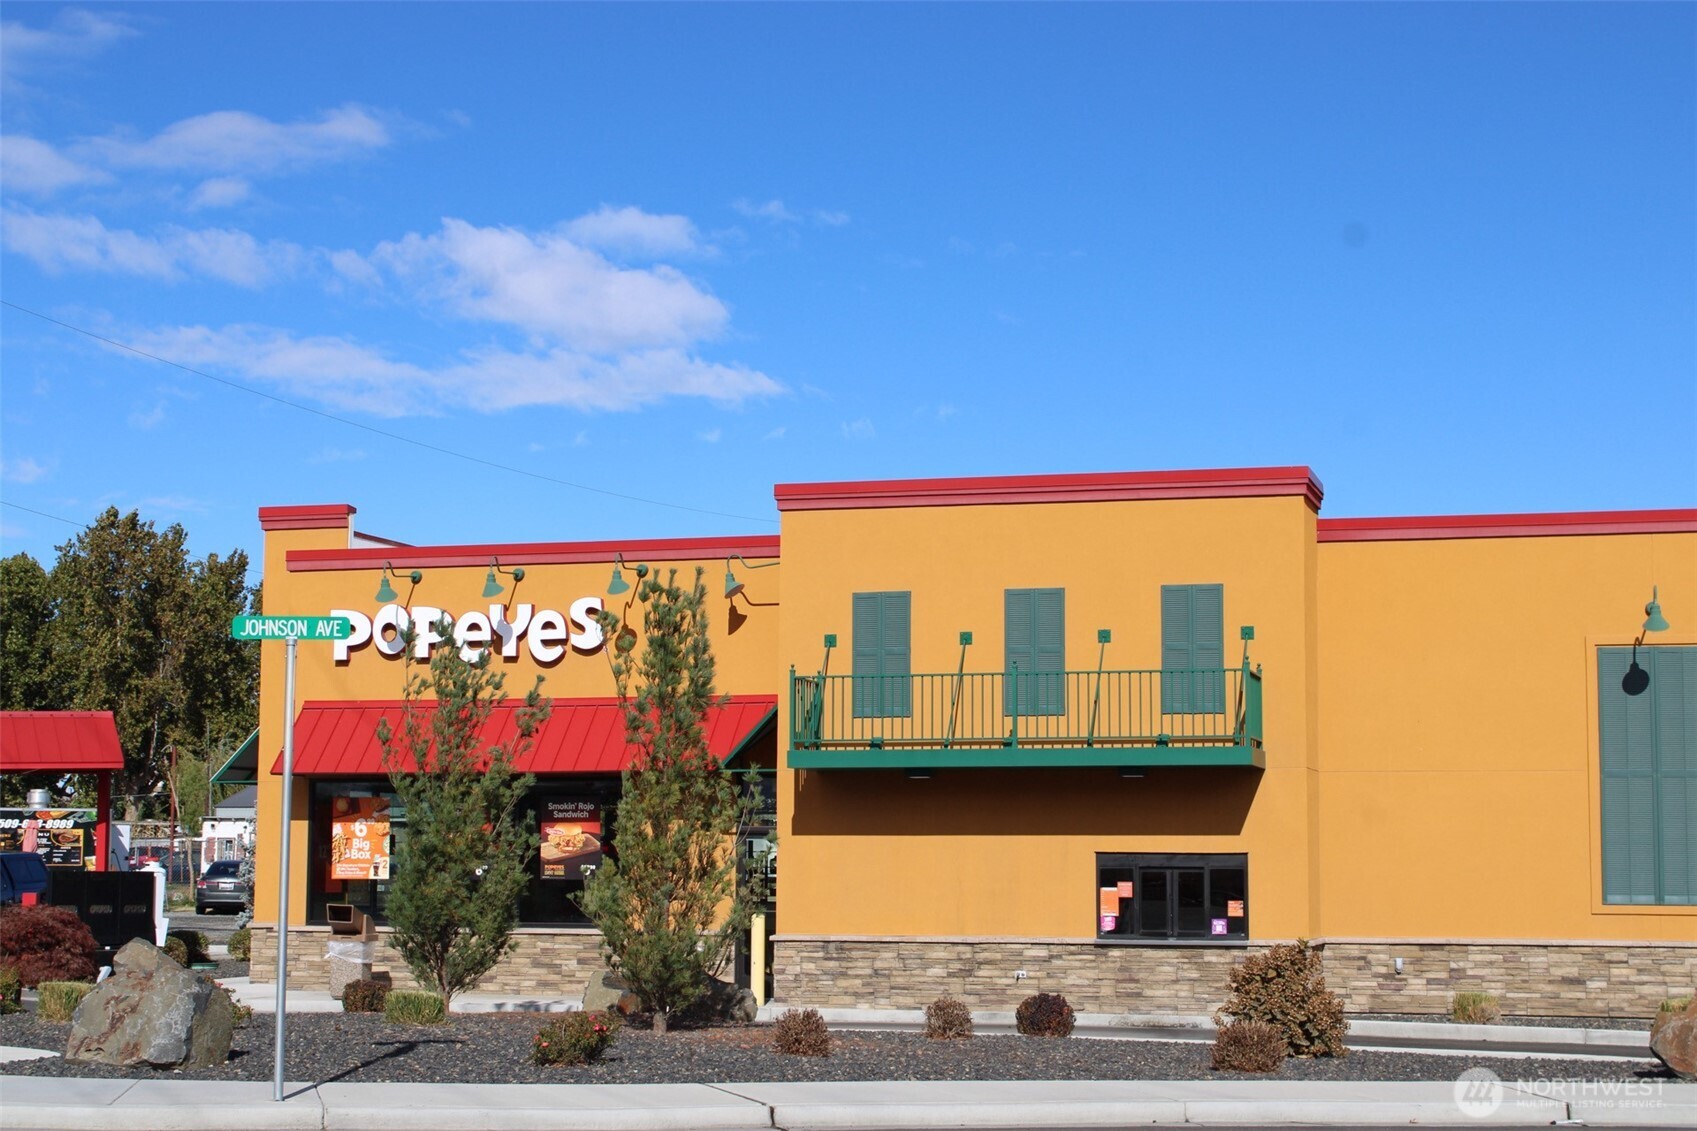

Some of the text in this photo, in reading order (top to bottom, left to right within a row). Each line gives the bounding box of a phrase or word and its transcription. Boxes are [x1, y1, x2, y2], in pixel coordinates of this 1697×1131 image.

[240, 619, 343, 636] JOHNSON AVE
[548, 802, 577, 810] Smokin'
[578, 802, 595, 811] Rojo
[352, 838, 370, 851] Big
[351, 849, 371, 859] Box
